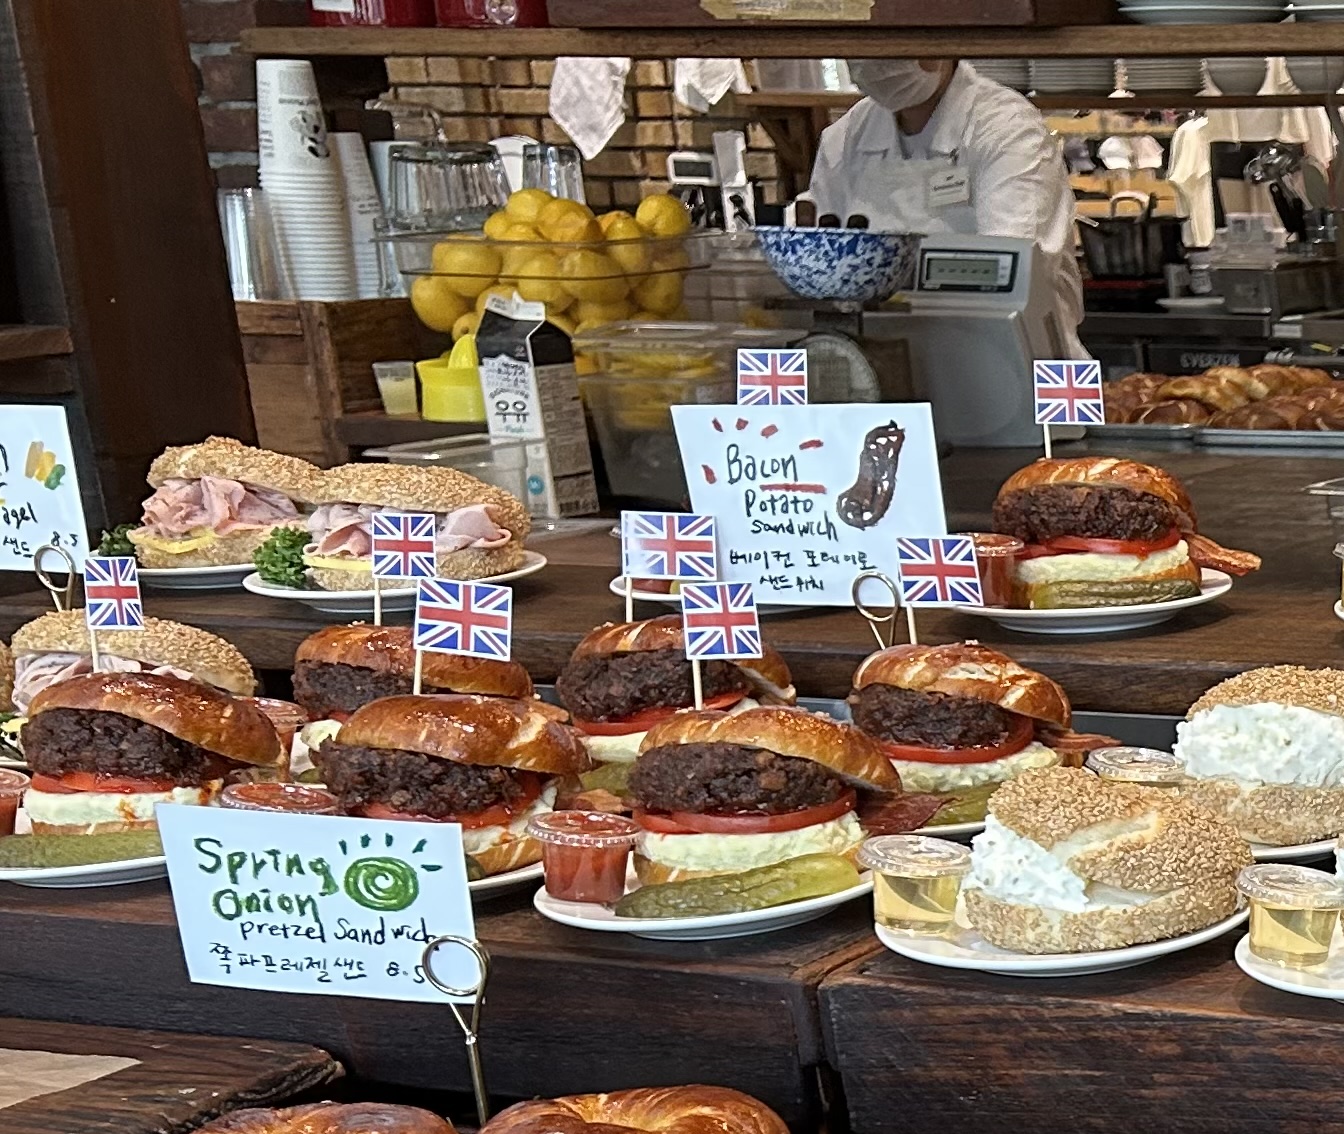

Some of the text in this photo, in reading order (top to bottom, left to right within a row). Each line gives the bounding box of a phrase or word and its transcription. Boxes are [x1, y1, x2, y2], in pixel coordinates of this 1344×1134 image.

[727, 443, 798, 485] Bacon
[1, 502, 38, 529] agel
[745, 489, 814, 517] Potato
[730, 550, 795, 569] 베이컨
[193, 837, 340, 896] Spring
[212, 888, 320, 923] Onion
[386, 962, 425, 984] 8.5
